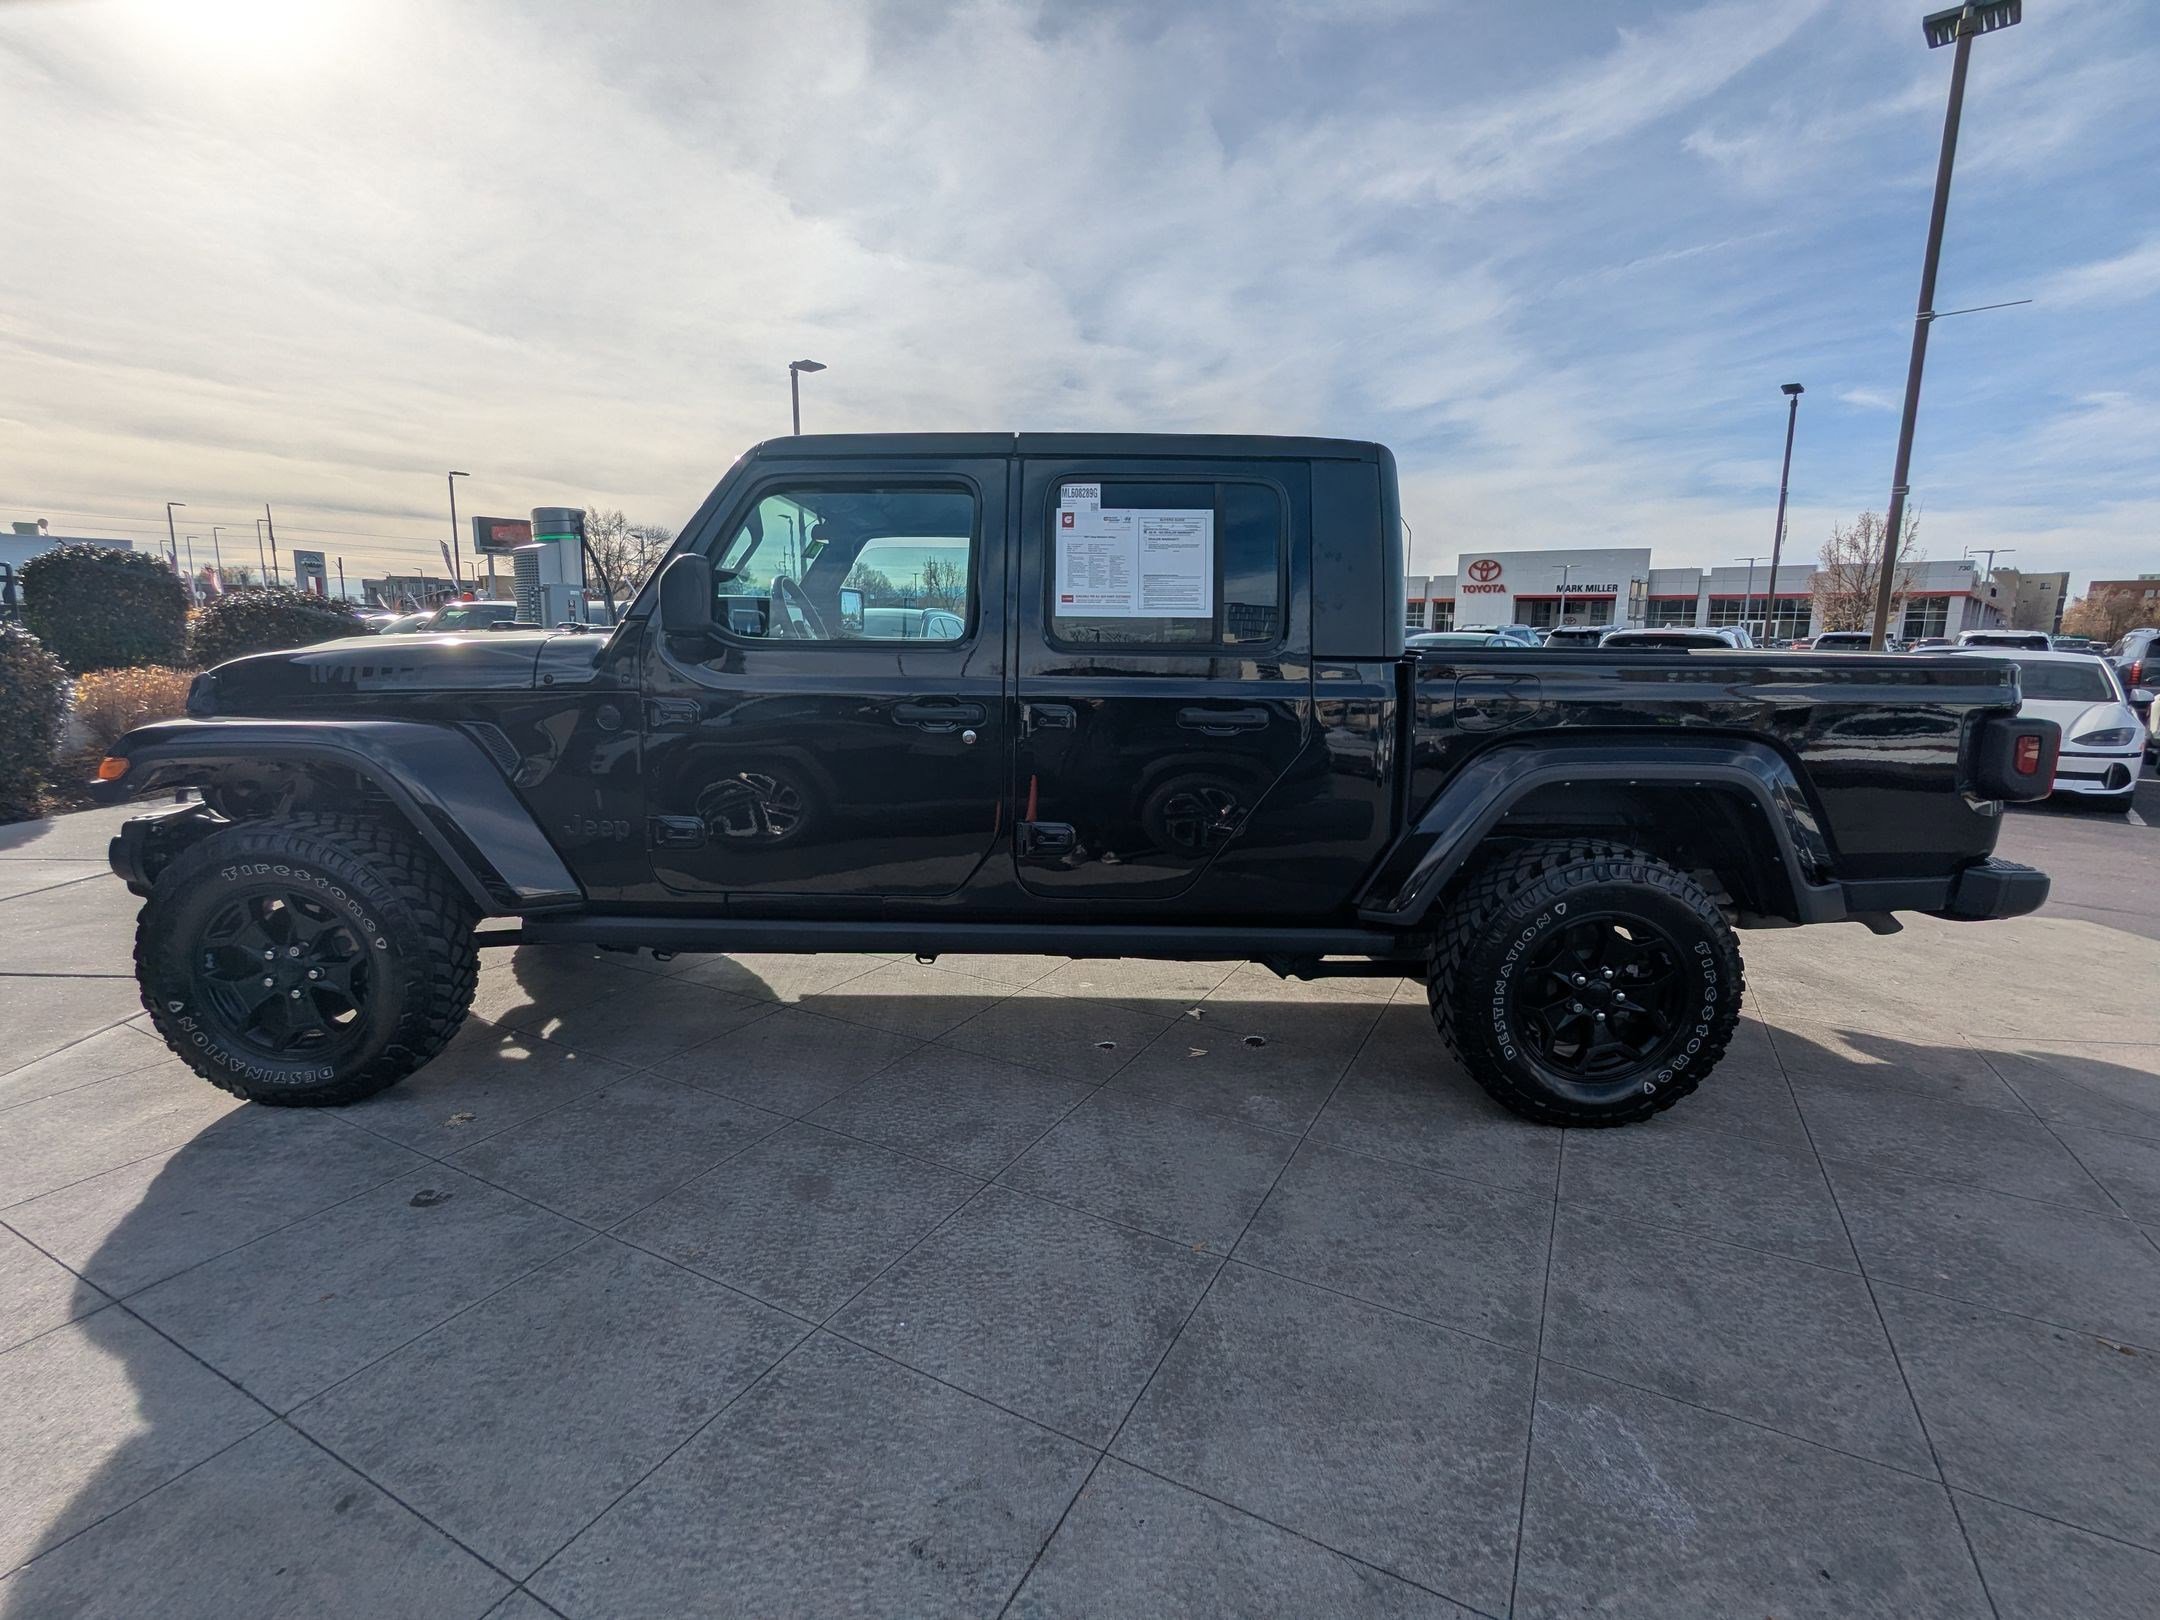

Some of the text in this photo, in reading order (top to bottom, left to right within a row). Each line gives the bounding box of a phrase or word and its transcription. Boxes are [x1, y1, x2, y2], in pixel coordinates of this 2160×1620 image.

[1461, 584, 1507, 594] TOYOTA
[1555, 583, 1619, 593] MARK MILLER
[563, 813, 631, 841] Jeep
[1492, 913, 1552, 1061] DESTINATION
[177, 1015, 335, 1085] DESTINATION
